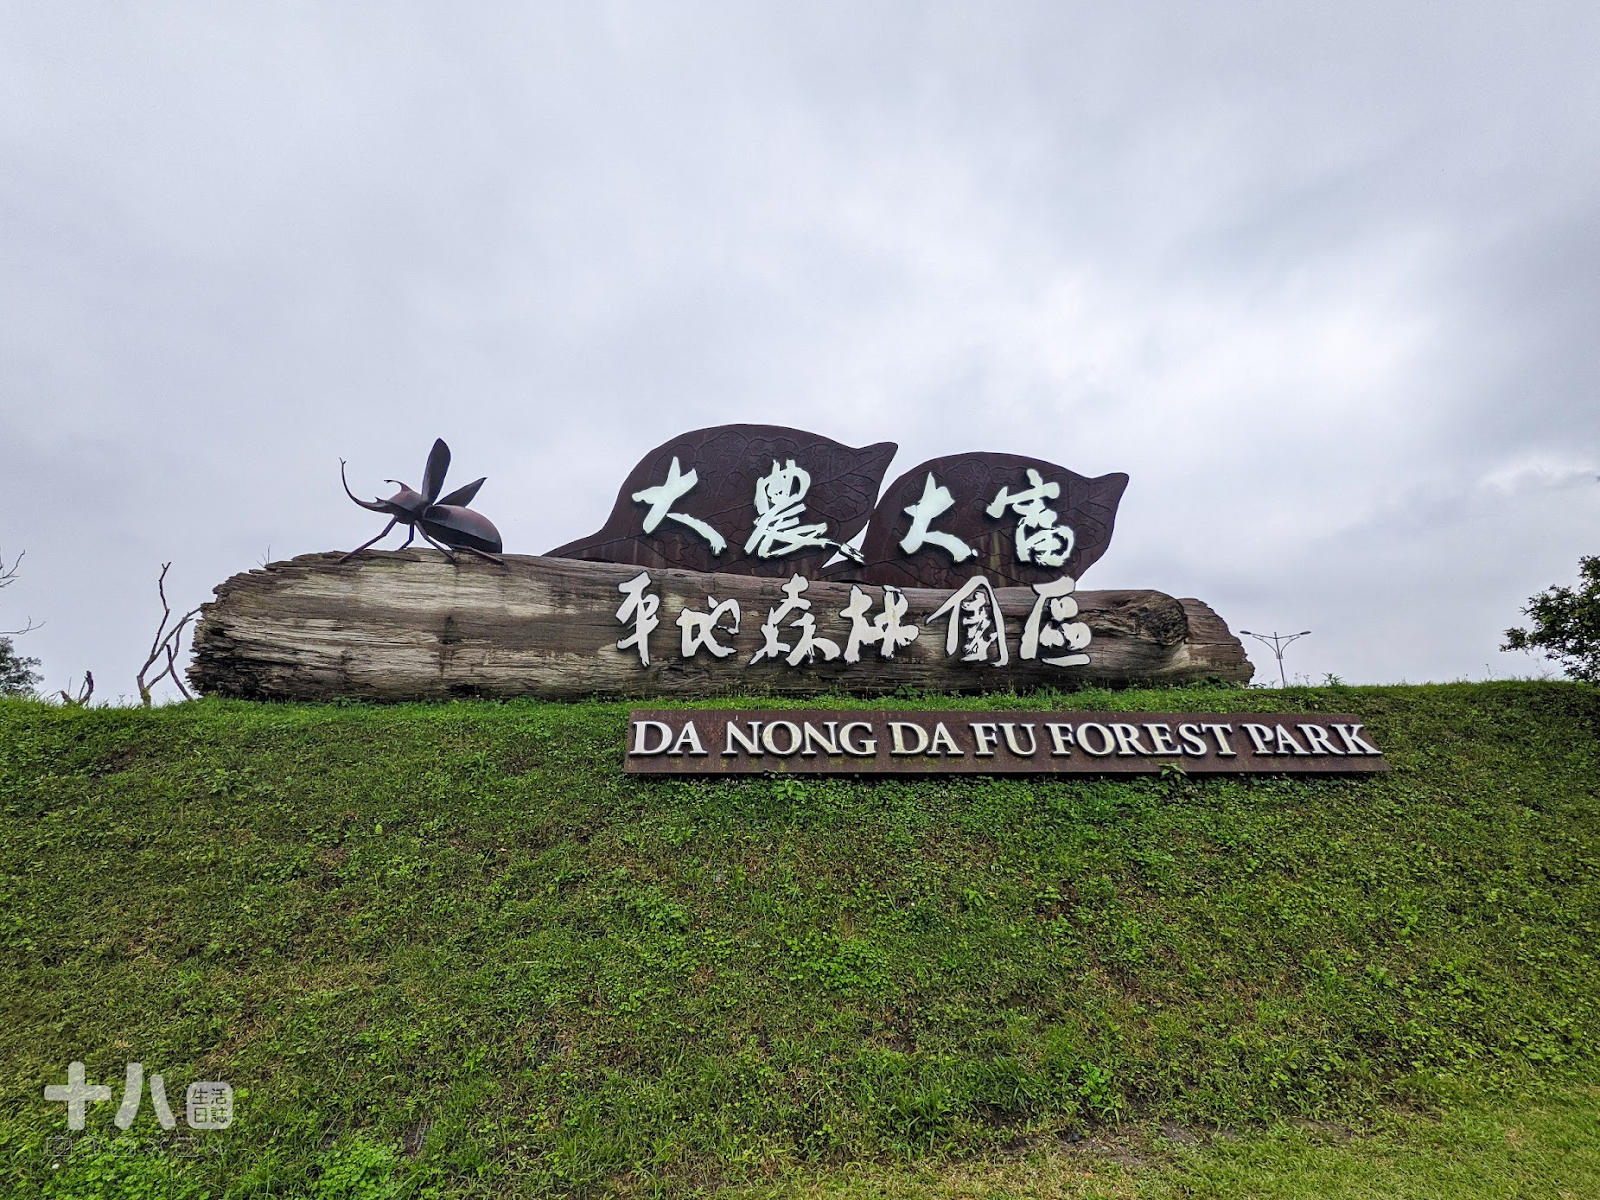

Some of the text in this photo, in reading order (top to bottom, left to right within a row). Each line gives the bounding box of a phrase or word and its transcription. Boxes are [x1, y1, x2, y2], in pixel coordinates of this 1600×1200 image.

[615, 572, 1092, 667] 平地森林園區
[629, 720, 1383, 757] DA NONG DA FU FOREST PARK
